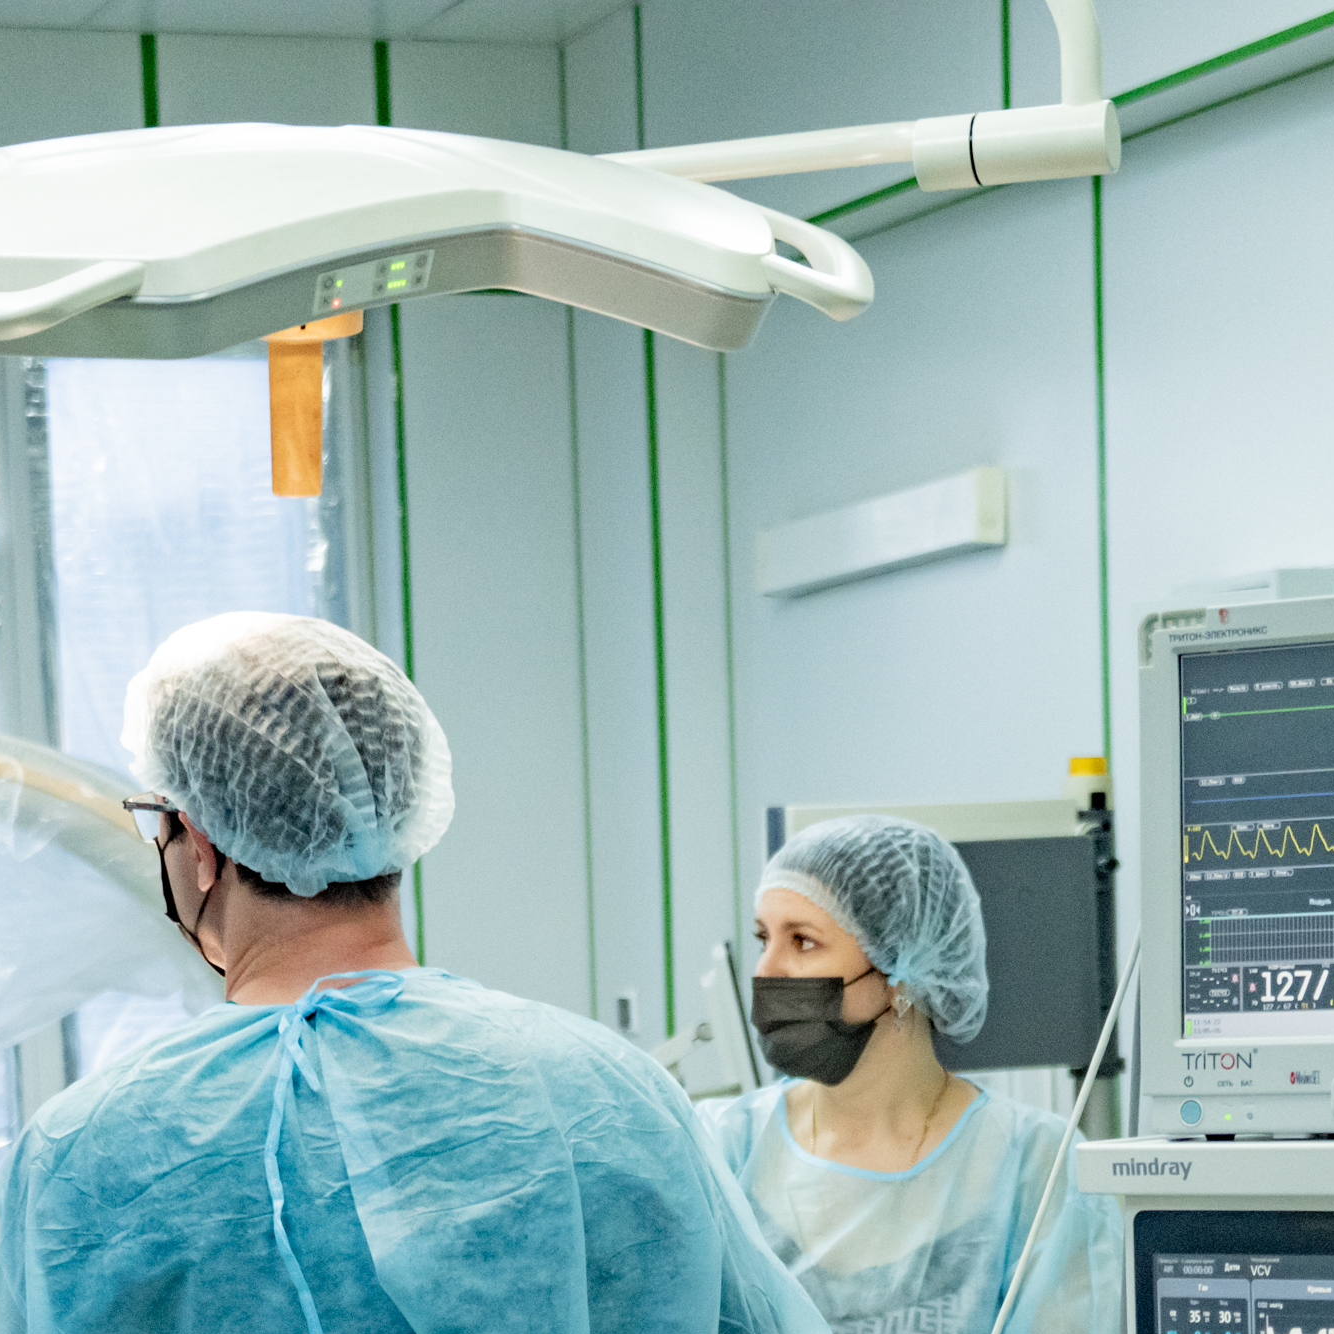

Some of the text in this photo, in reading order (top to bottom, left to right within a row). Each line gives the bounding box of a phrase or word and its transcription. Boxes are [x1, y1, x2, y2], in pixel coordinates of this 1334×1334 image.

[1168, 626, 1267, 643] ТРИТОН-ЭЛЕКТРОНИКС
[1112, 1157, 1192, 1180] mindray
[1224, 1263, 1241, 1273] Дети
[1250, 1265, 1271, 1277] VCV
[1189, 1310, 1201, 1323] 35
[1219, 1310, 1231, 1324] 30
